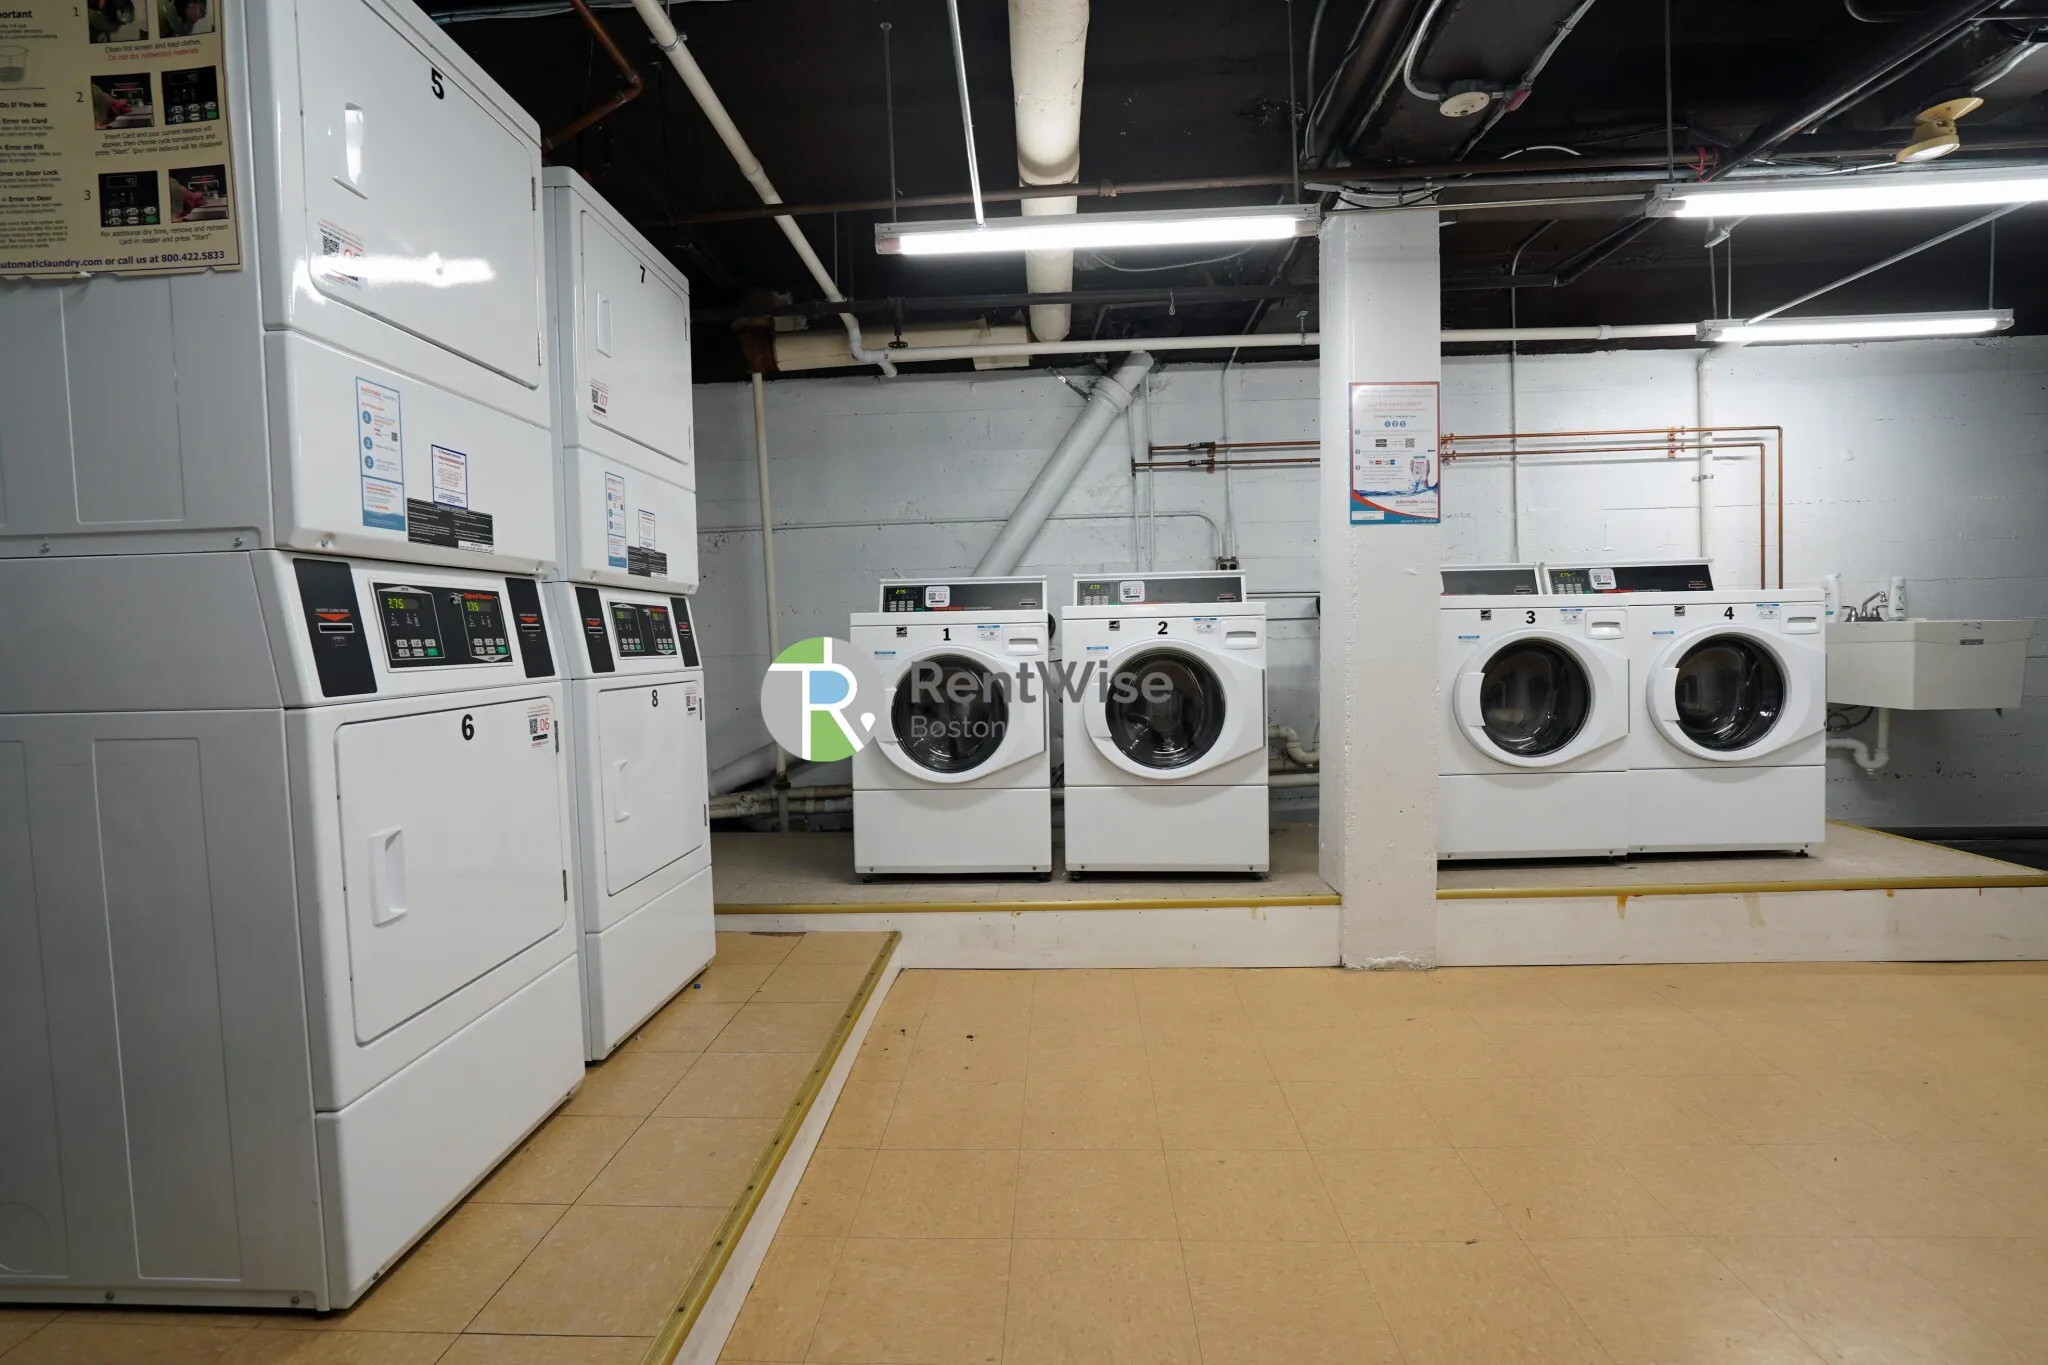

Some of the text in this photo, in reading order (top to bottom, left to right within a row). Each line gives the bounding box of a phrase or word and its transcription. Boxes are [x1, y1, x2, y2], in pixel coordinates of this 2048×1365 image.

[74, 7, 80, 16] 1
[431, 67, 445, 99] 5
[76, 92, 84, 102] 2
[199, 140, 223, 148] displayed
[84, 190, 91, 200] 3
[118, 256, 133, 265] call
[150, 255, 159, 263] at
[161, 250, 225, 263] 800.422.5833
[639, 264, 645, 283] 7
[1526, 610, 1536, 624] 3
[1724, 606, 1734, 620] 4
[943, 628, 951, 641] 1
[1157, 621, 1168, 635] 2
[652, 690, 658, 707] 8
[462, 714, 474, 741] 6
[540, 718, 550, 731] 06
